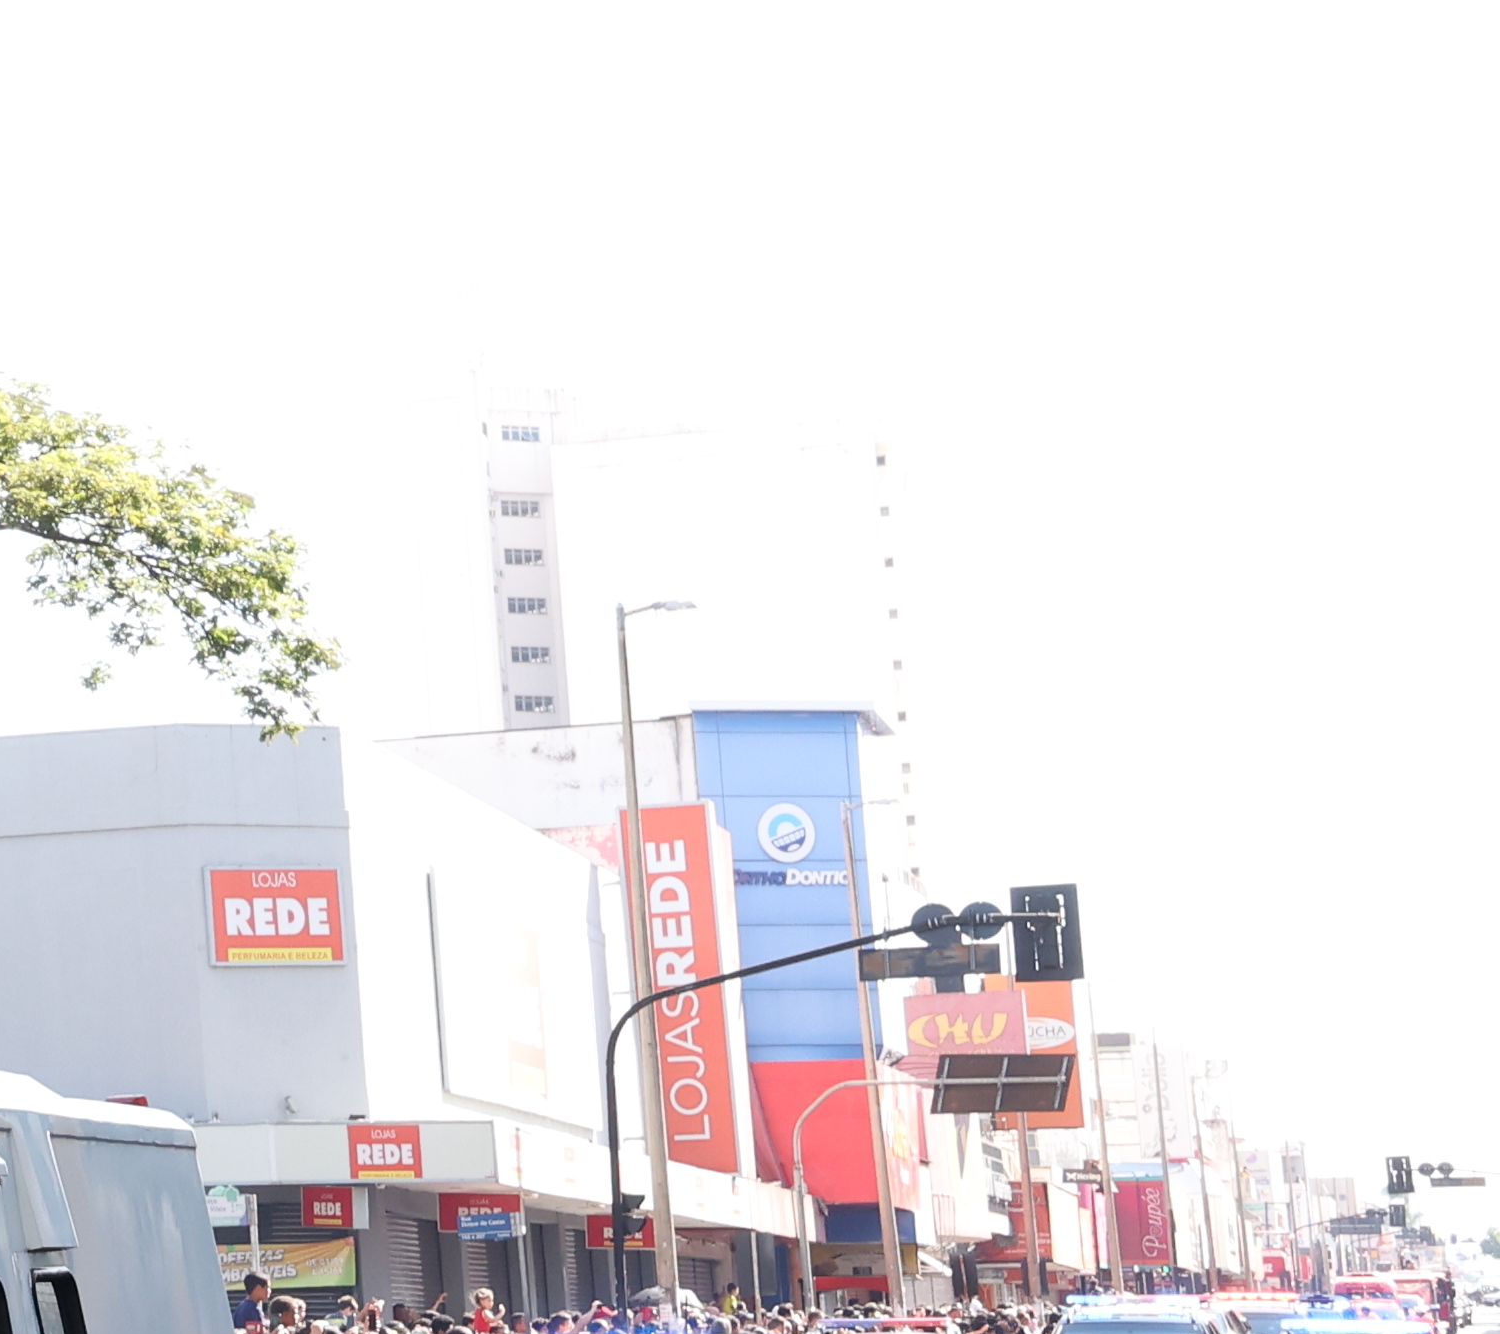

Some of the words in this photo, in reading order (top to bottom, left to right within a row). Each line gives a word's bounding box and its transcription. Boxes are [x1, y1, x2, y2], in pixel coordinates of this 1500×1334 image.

[252, 872, 297, 888] LOJAS
[224, 897, 331, 936] REDE
[645, 838, 698, 989] REDE
[232, 952, 285, 961] PERFUMARIA
[288, 952, 293, 960] E
[296, 951, 329, 960] BELEZA
[661, 989, 712, 1142] LOJAS
[371, 1129, 397, 1139] LOJAS
[356, 1143, 415, 1165] REDE
[313, 1201, 342, 1216] REDE
[1142, 1187, 1167, 1257] Poupée
[603, 1227, 643, 1239] RE
